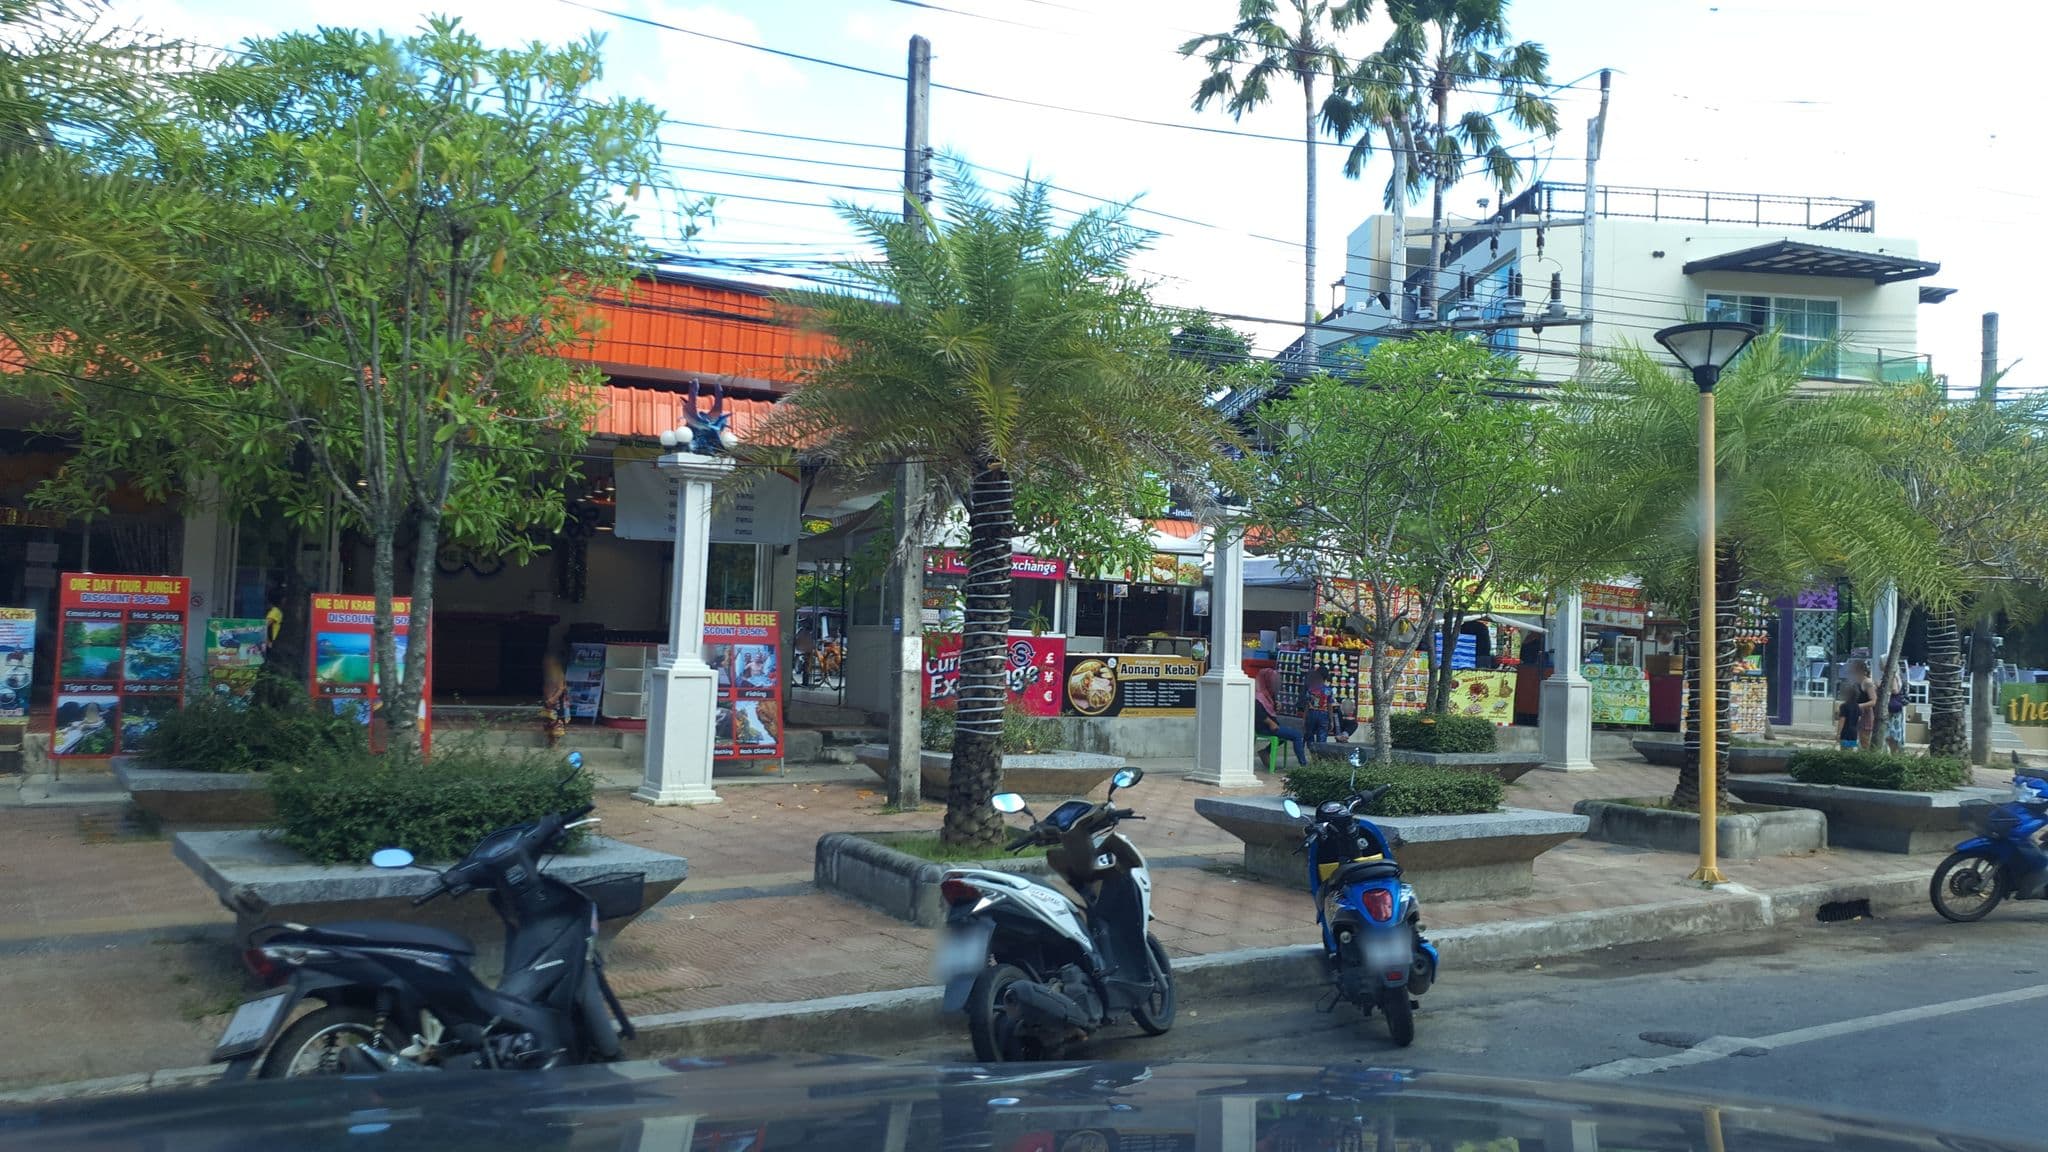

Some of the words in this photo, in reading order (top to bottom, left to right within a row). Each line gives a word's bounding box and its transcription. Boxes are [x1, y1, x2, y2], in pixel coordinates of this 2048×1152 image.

[70, 578, 91, 590] ONE
[92, 579, 114, 591] DAY
[115, 580, 142, 592] TOUR
[143, 582, 181, 593] JUNGLE
[81, 593, 131, 603] DISCOUNT
[315, 598, 332, 608] ONE
[333, 600, 350, 609] DAY
[152, 612, 179, 621] Spring
[745, 613, 776, 626] HERE
[1120, 664, 1160, 677] Aonang
[1165, 664, 1196, 675] Kebab
[64, 684, 87, 692] Tiger
[2008, 694, 2048, 721] the
